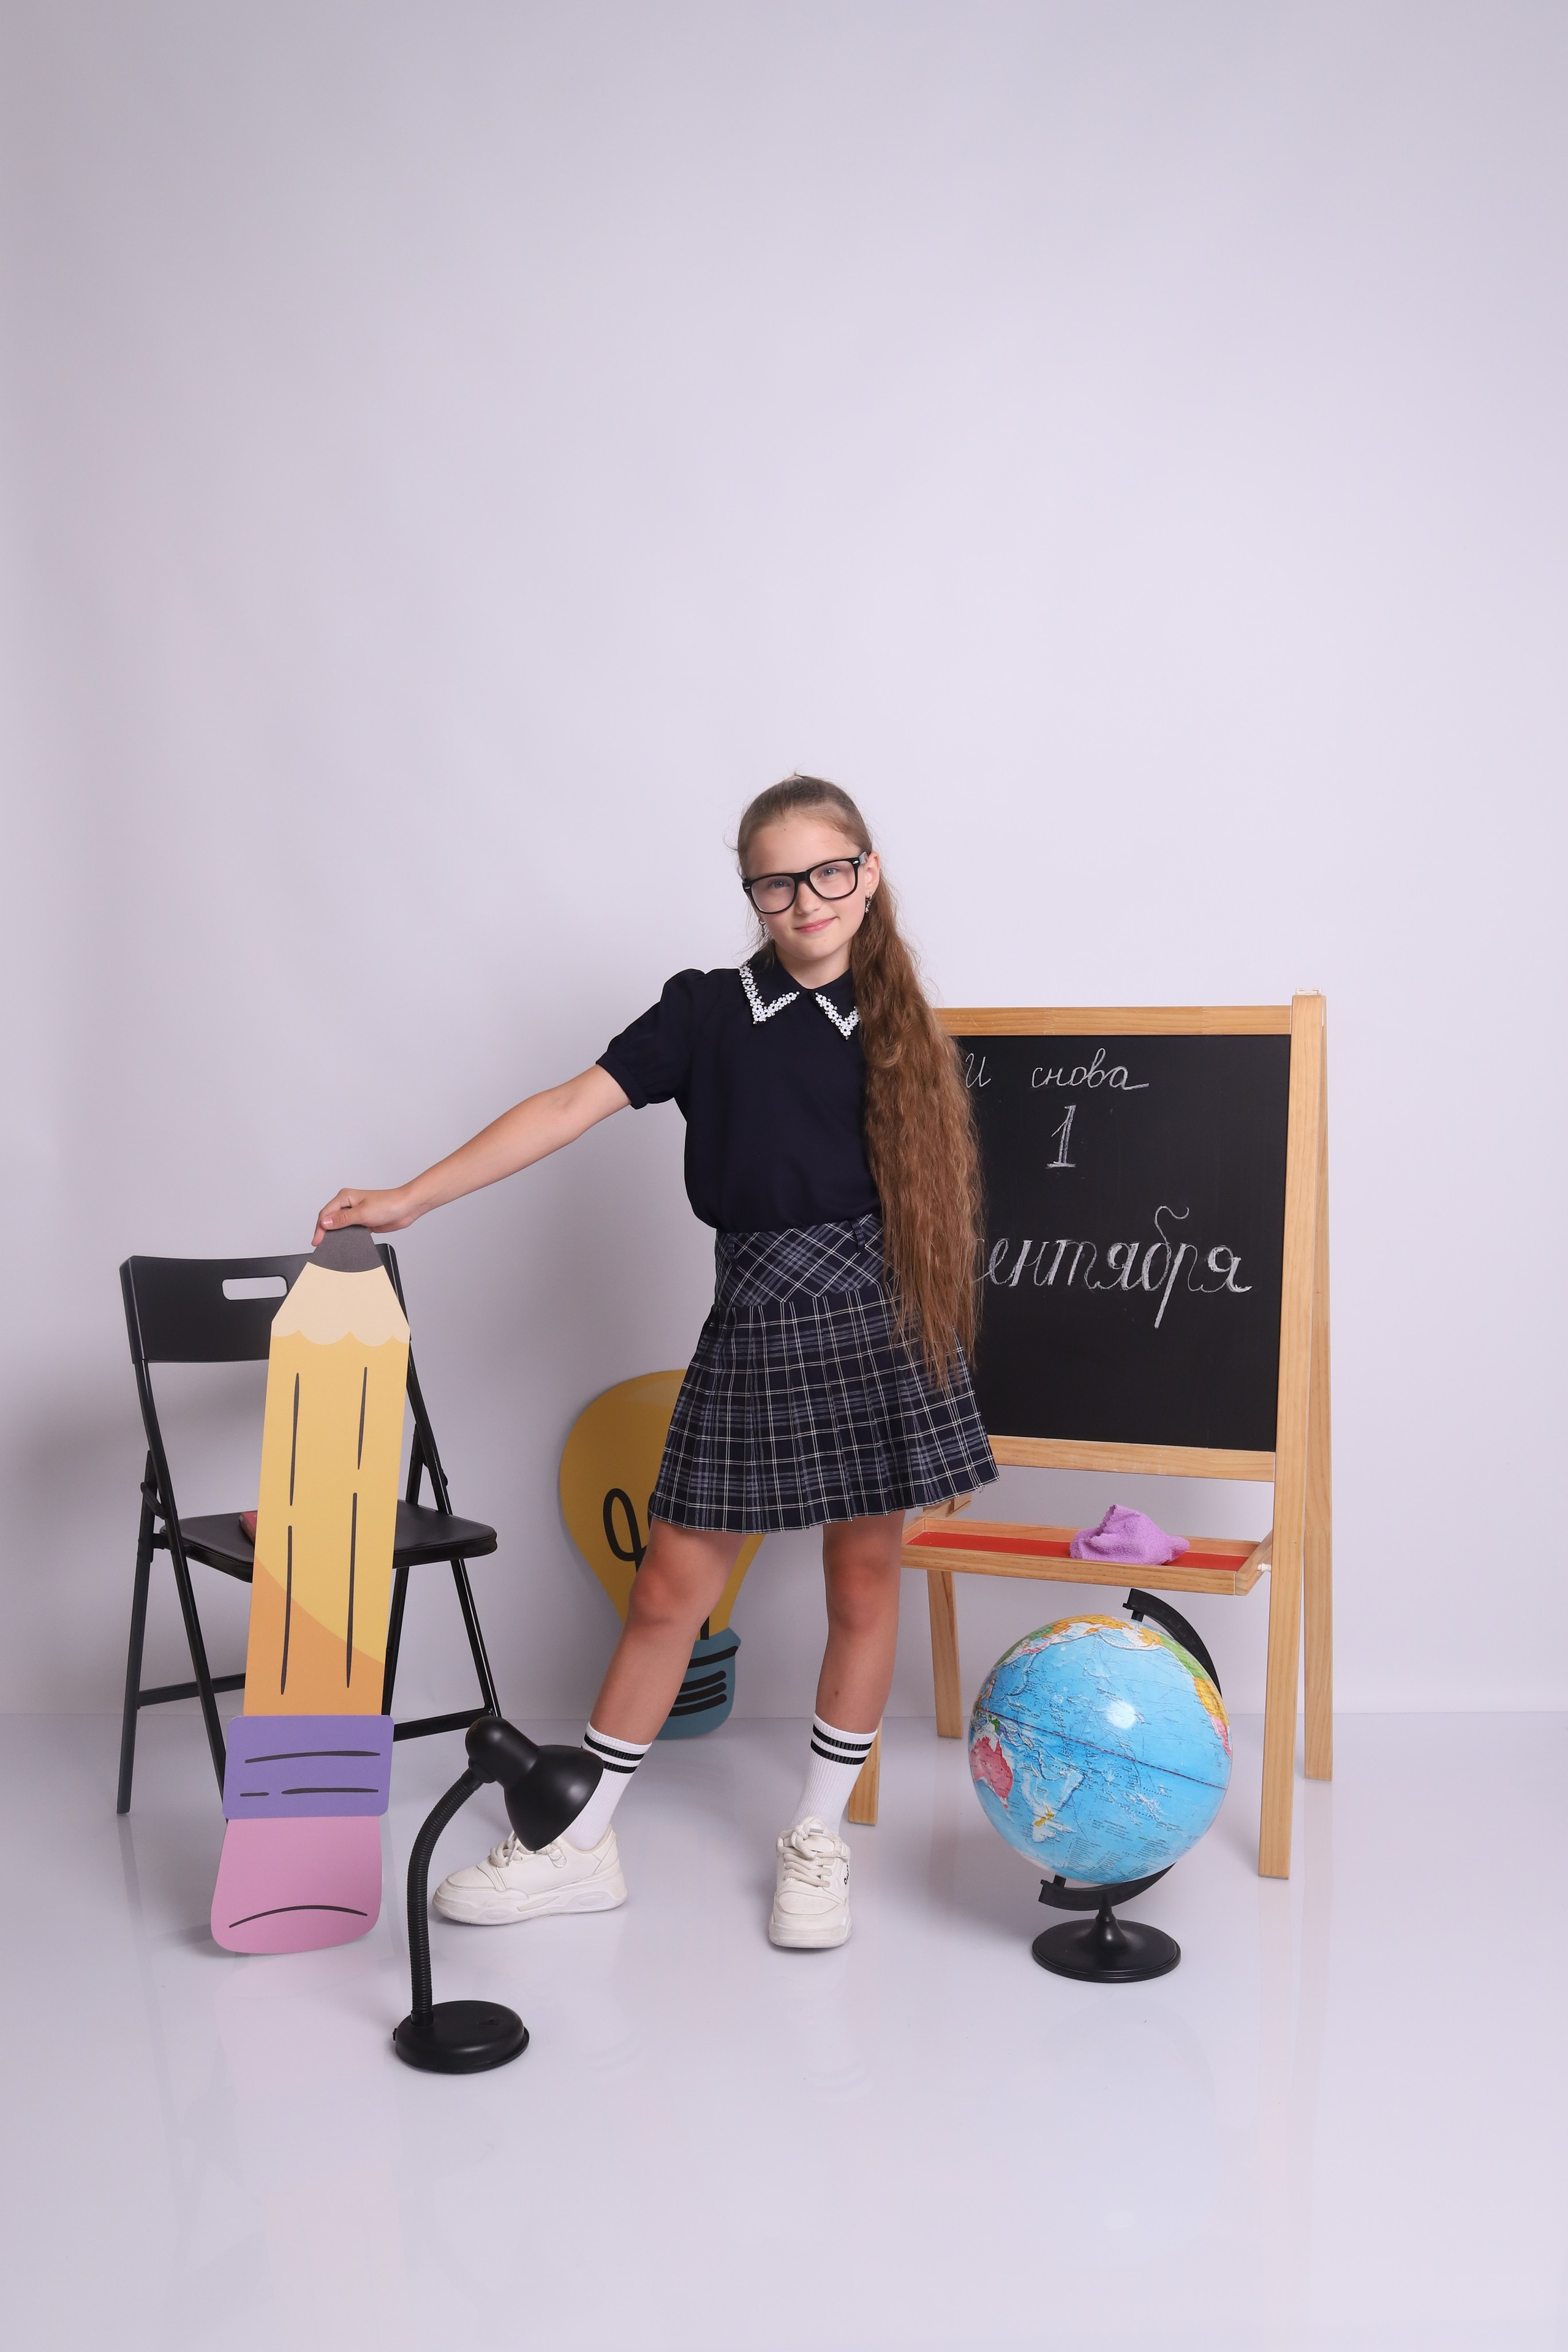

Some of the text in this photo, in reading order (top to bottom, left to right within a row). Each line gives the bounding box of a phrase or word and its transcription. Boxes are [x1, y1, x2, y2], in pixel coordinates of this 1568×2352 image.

[965, 1048, 1149, 1090] И снова
[1046, 1104, 1076, 1169] 1
[973, 1205, 1253, 1330] ентября
